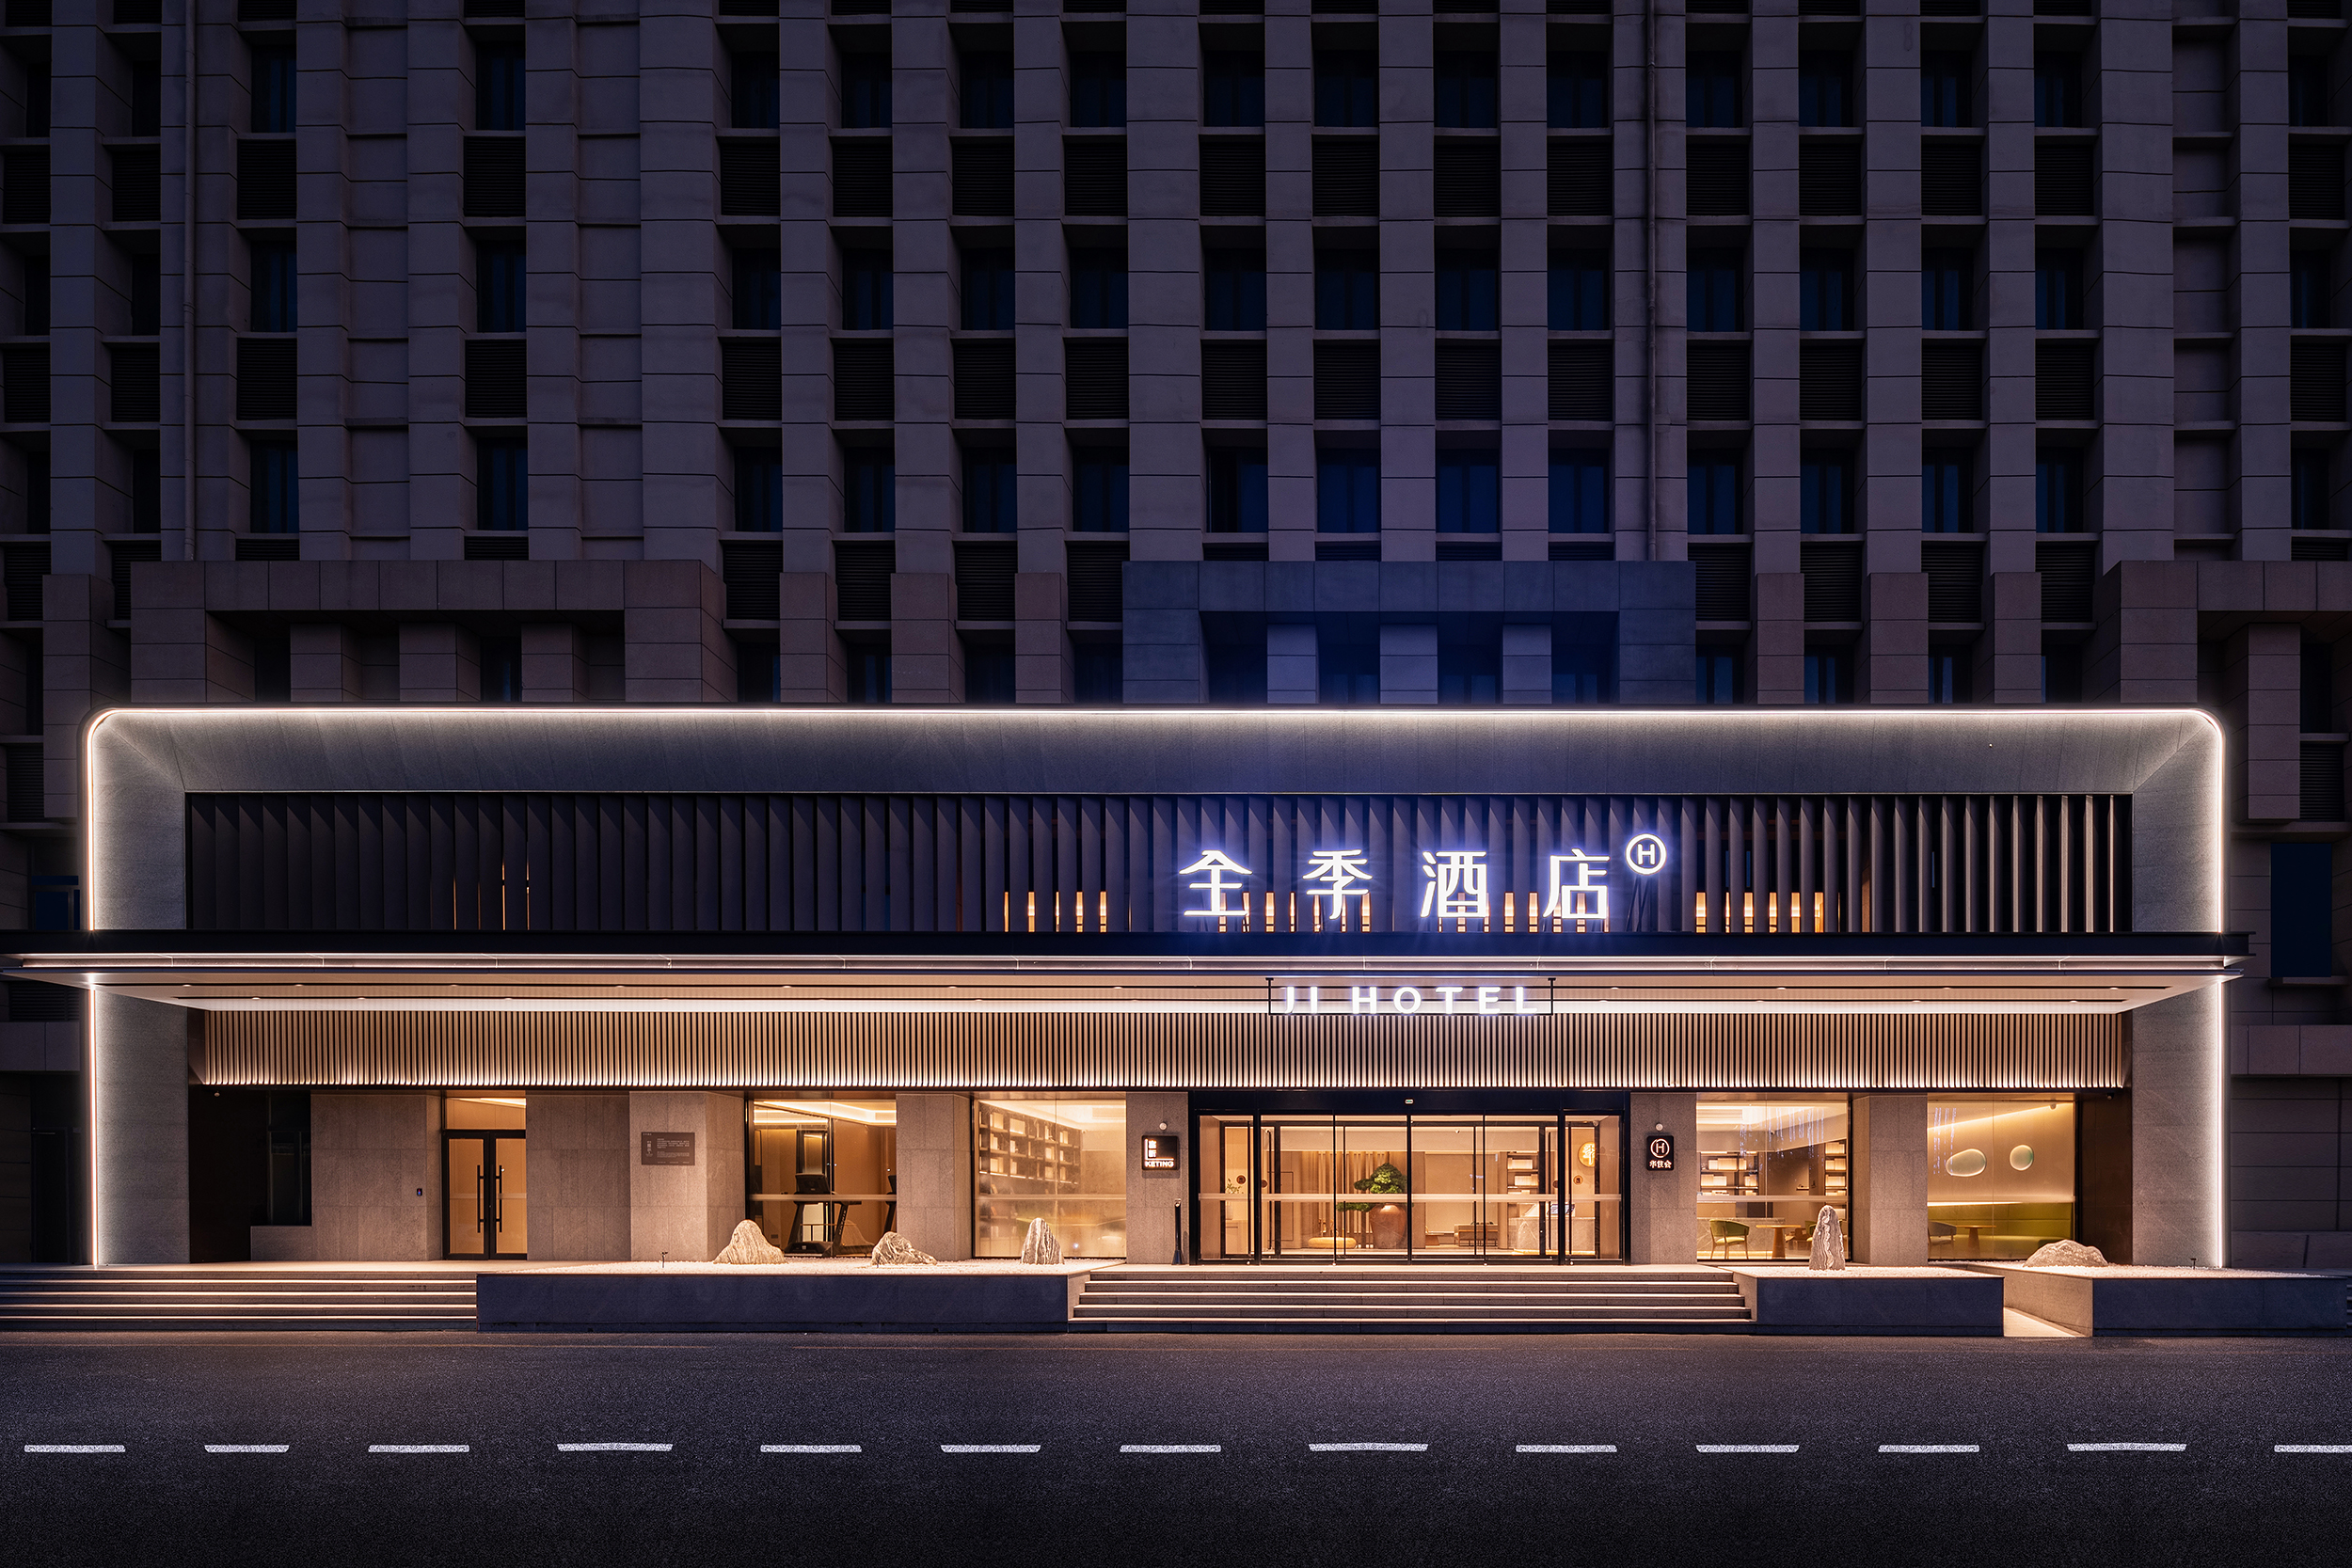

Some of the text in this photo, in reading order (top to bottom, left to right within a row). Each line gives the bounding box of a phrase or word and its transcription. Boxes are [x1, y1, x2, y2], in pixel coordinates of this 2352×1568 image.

[1179, 848, 1610, 920] 全季酒店
[1283, 986, 1539, 1014] JI HOTEL
